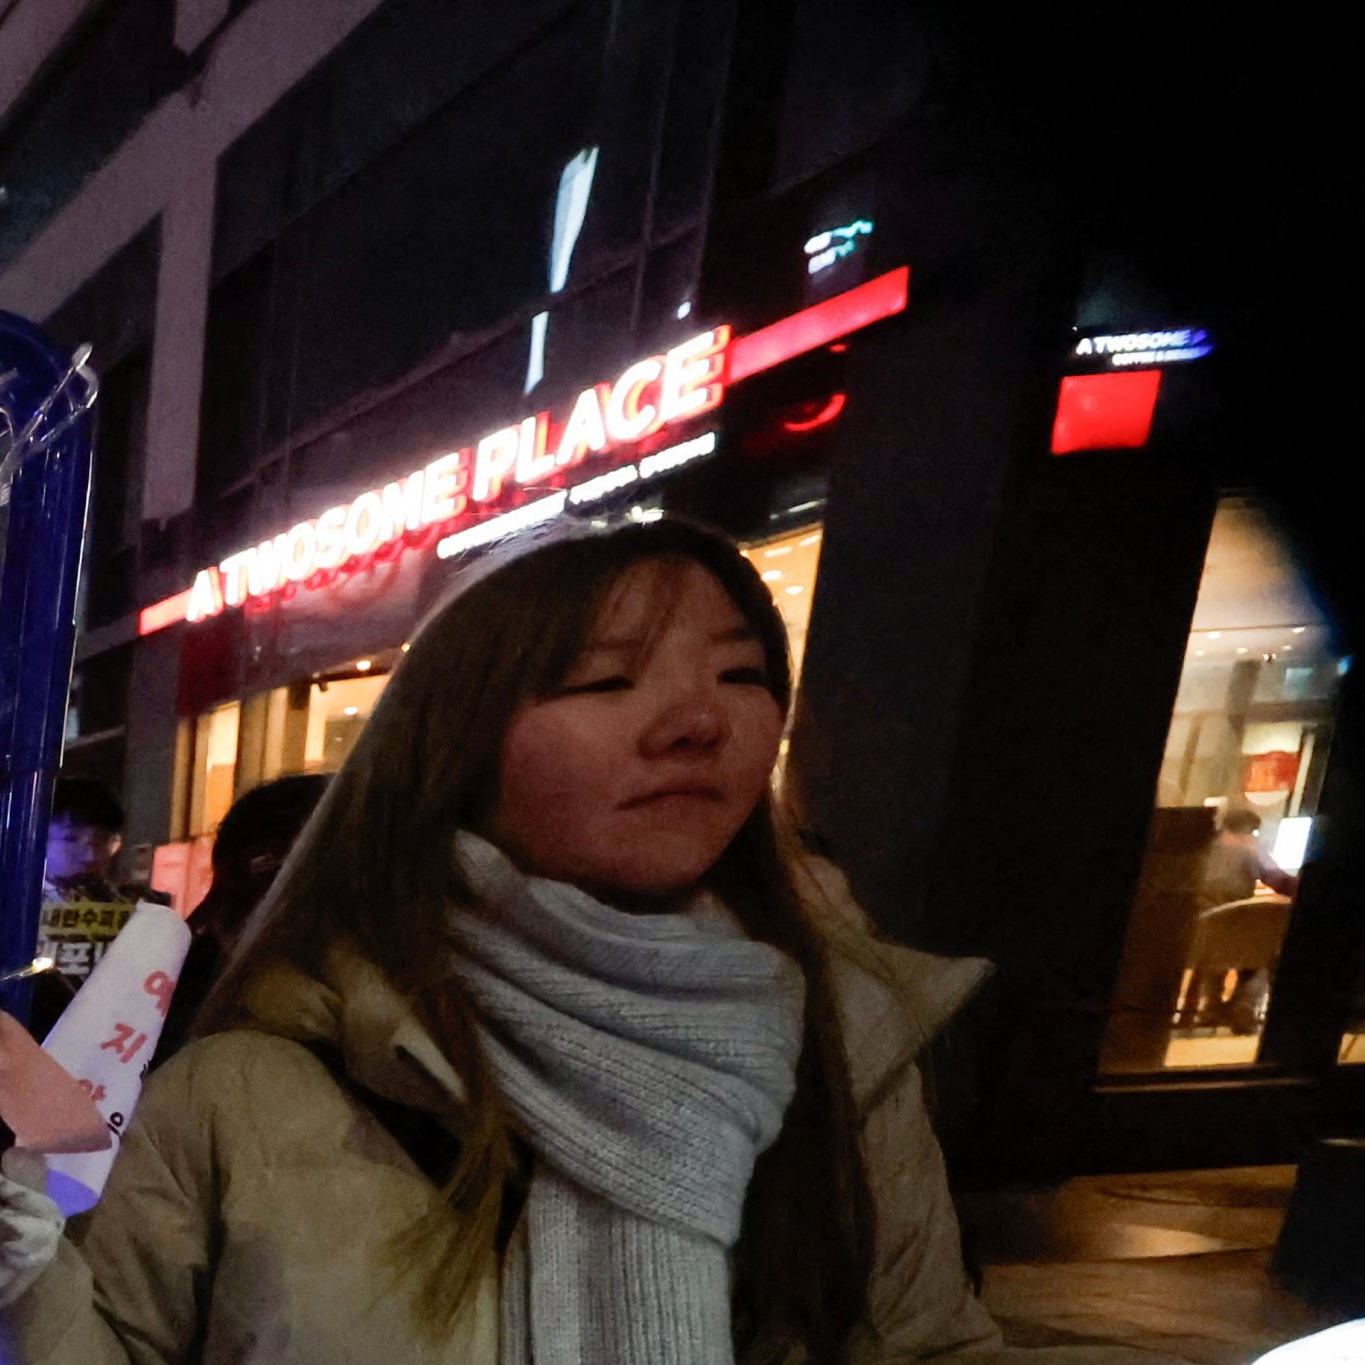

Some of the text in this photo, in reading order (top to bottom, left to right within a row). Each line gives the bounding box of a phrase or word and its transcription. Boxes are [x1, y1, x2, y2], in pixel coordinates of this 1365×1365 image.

[185, 568, 224, 622] A
[220, 452, 469, 607] TWOSOME
[472, 326, 731, 501] PLACE
